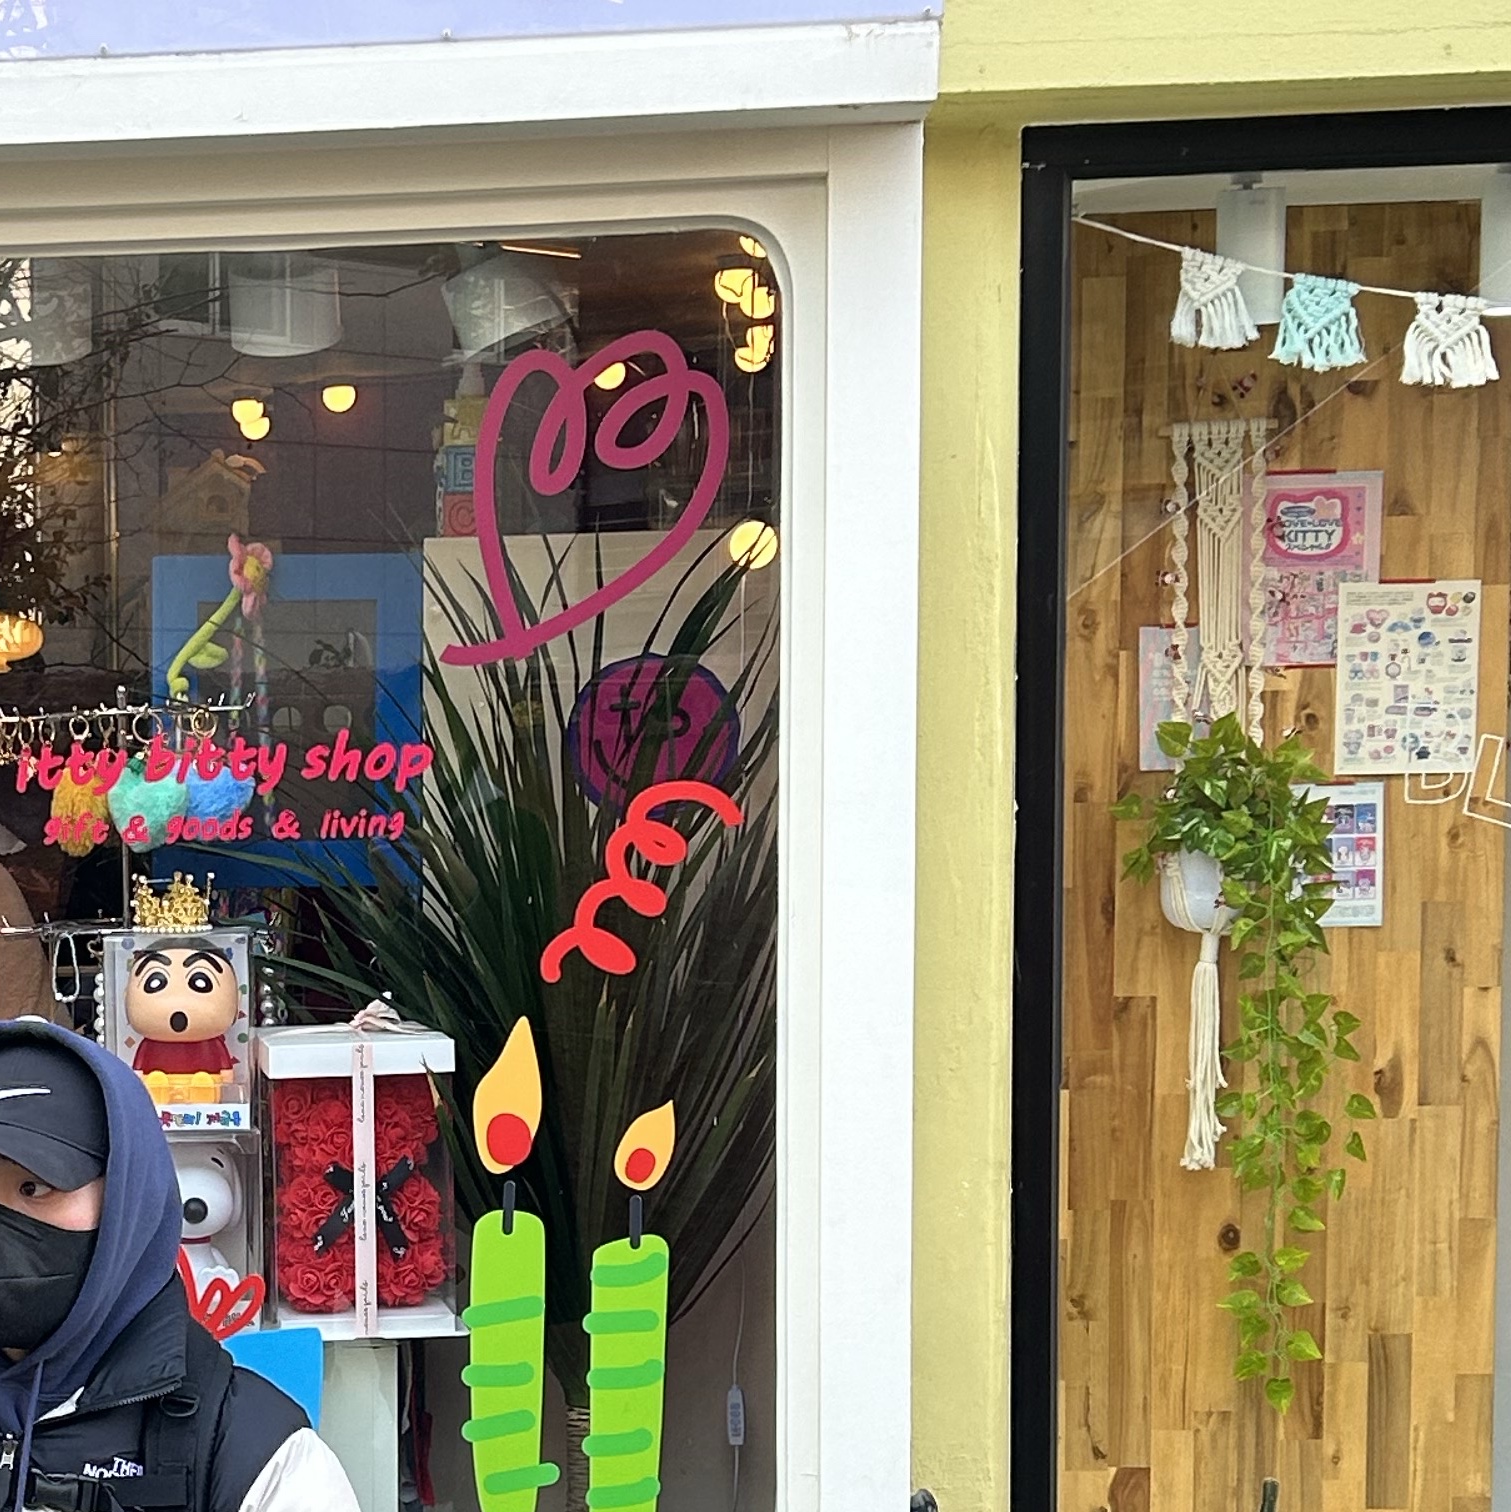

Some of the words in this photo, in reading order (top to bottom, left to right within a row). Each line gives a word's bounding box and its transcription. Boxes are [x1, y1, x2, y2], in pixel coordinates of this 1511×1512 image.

[16, 741, 128, 795] itty
[144, 733, 287, 795] bitty
[301, 728, 434, 792] shop
[43, 812, 110, 846] gift
[122, 815, 150, 844] &
[165, 809, 253, 845] goods
[271, 810, 301, 840] &
[320, 809, 405, 841] living
